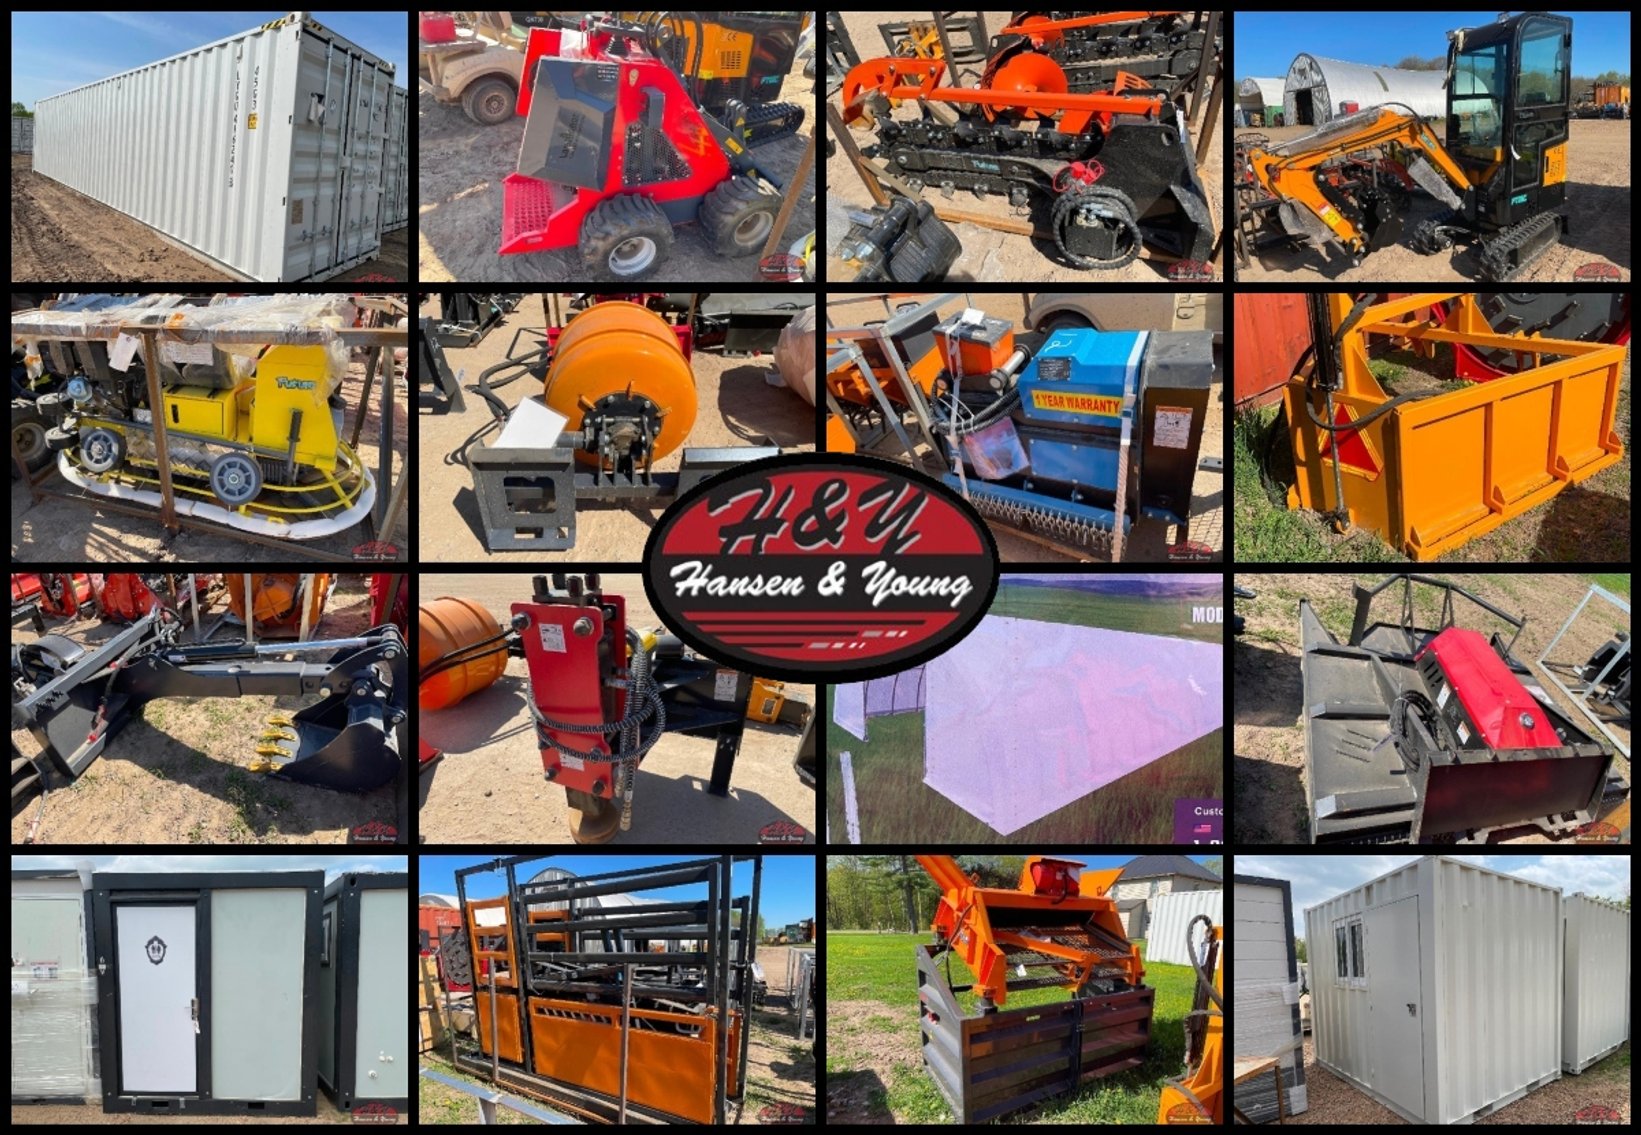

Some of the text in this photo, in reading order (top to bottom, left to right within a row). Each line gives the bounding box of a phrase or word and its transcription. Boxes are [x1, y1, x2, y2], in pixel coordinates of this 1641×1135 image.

[1042, 393, 1066, 409] YEAR
[1066, 396, 1120, 413] WARRANTY
[1192, 607, 1224, 623] MOD
